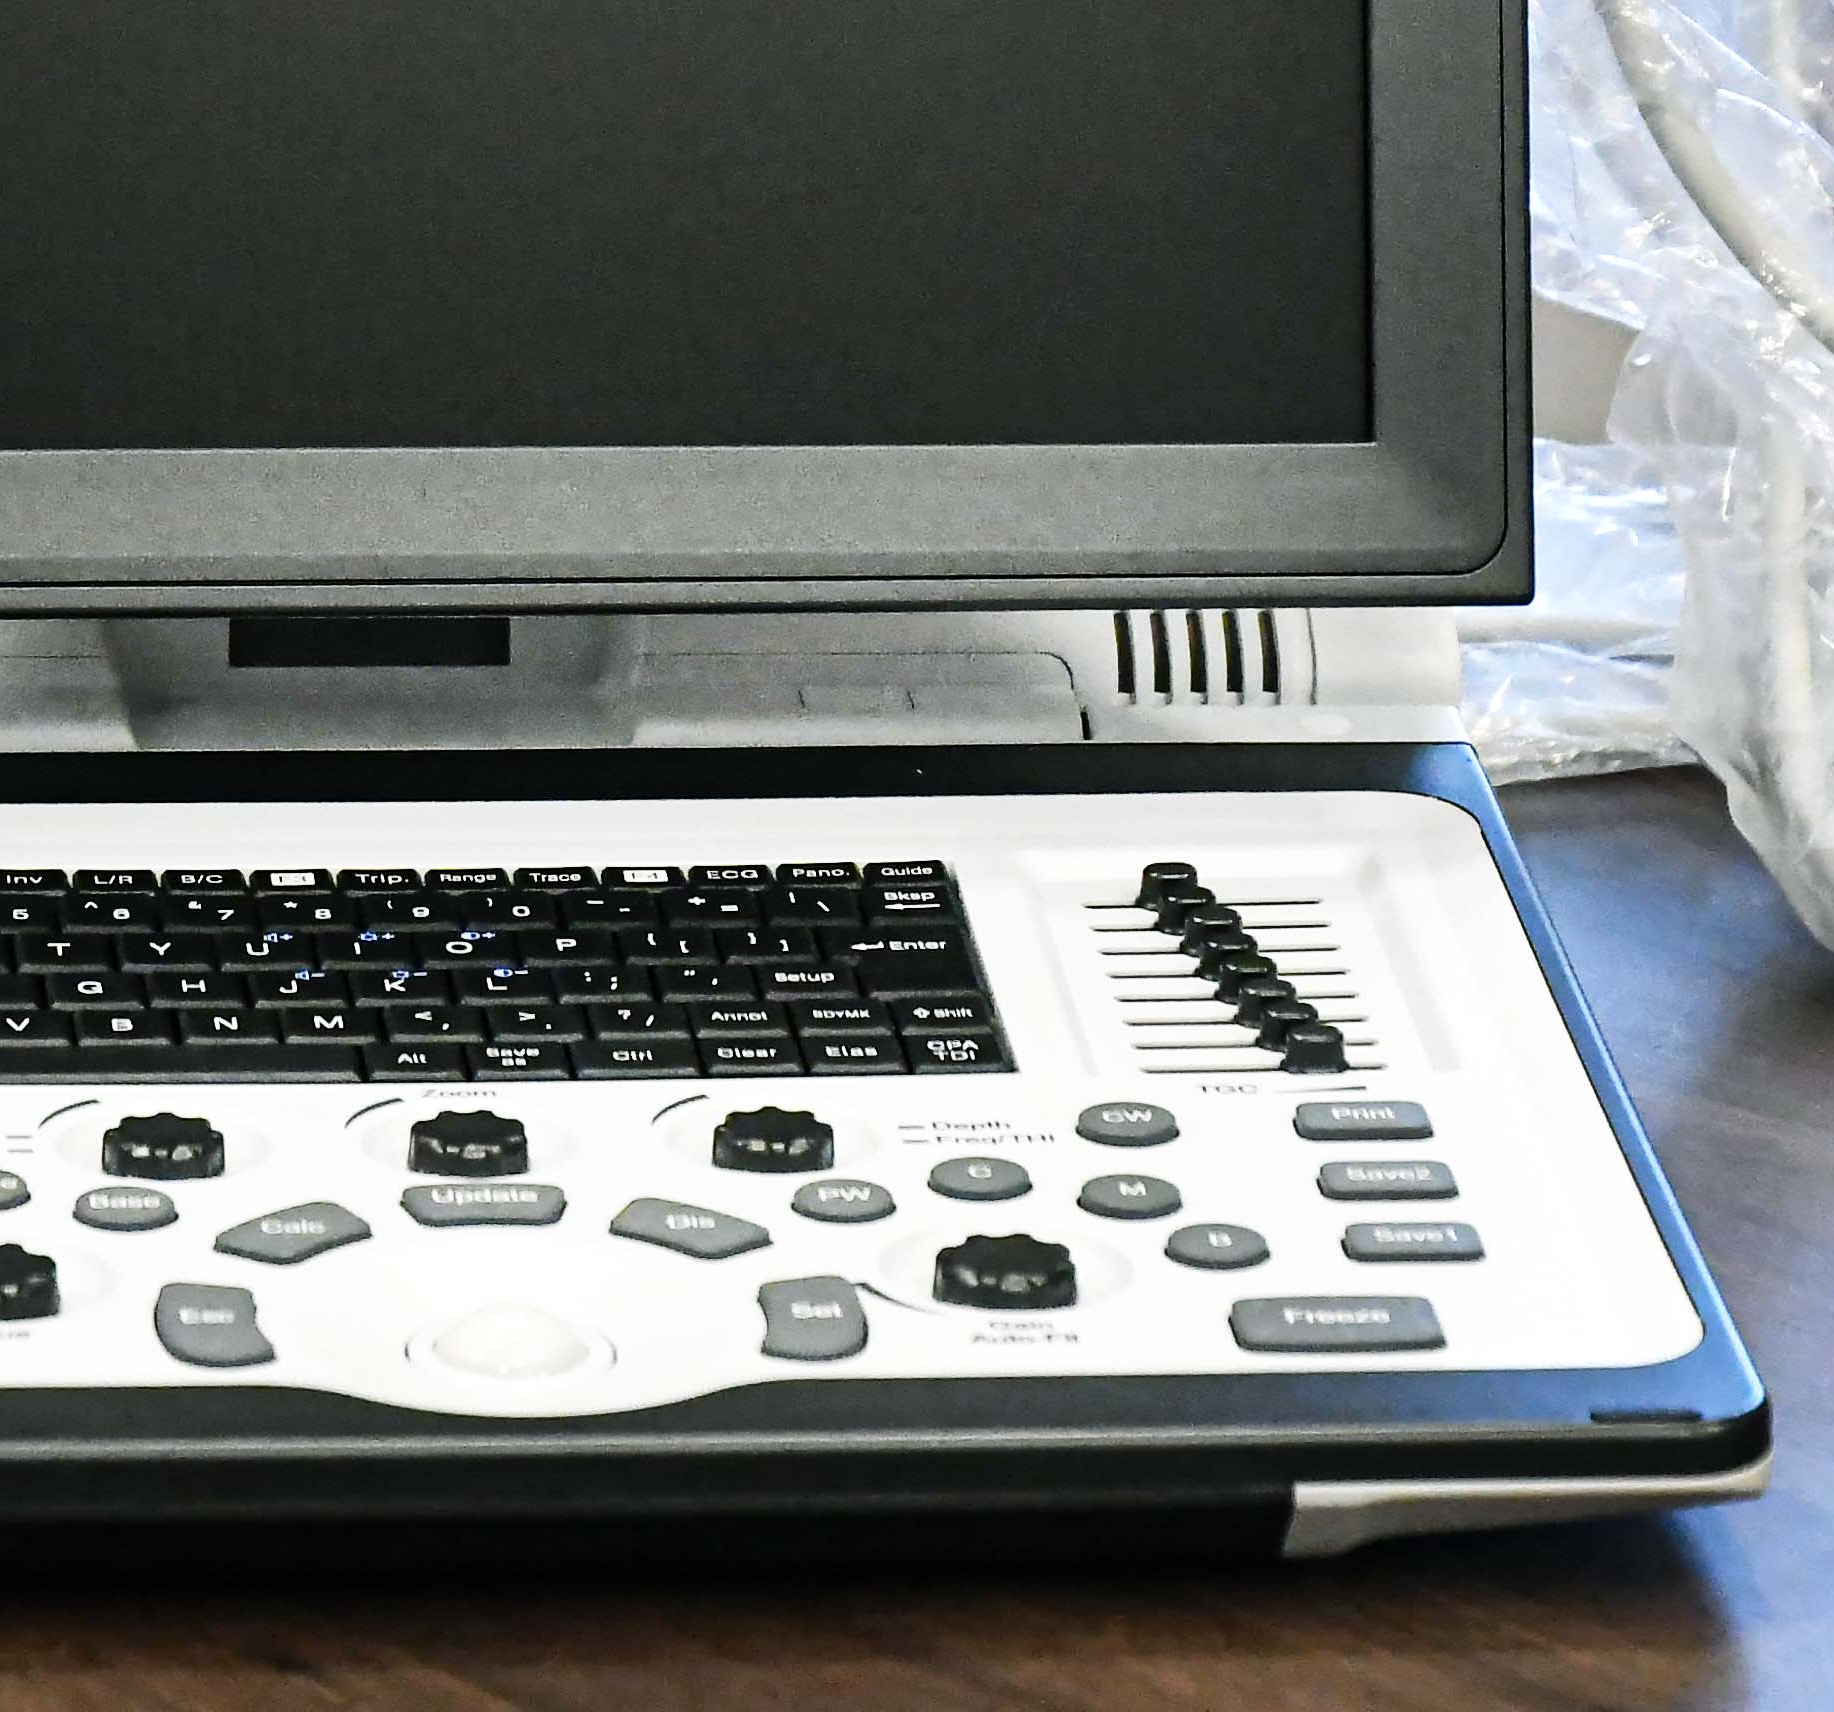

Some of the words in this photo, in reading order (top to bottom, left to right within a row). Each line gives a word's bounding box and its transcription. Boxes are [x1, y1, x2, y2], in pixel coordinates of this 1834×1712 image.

[707, 870, 758, 879] ECG
[793, 869, 849, 877] Pano.
[881, 866, 932, 875] Guide
[7, 875, 42, 883] Inv
[94, 876, 132, 884] L/R
[182, 875, 222, 883] B/C
[356, 874, 408, 884] Trip.
[440, 874, 496, 883] Range
[529, 873, 581, 882] Trace
[884, 891, 935, 901] Bksp
[13, 909, 29, 919] 5
[113, 909, 129, 919] 6
[218, 910, 234, 920] 7
[315, 909, 331, 919] 8
[413, 907, 429, 917] 9
[513, 906, 530, 917] 0
[47, 943, 70, 956] T
[150, 943, 171, 955] Y
[246, 943, 269, 956] U
[354, 942, 360, 954] I
[446, 942, 472, 953] O
[556, 939, 576, 951] P
[889, 941, 946, 950] Enter
[775, 973, 834, 983] Setup
[78, 981, 103, 994] G
[182, 980, 206, 992] H
[279, 980, 297, 994] J
[384, 979, 406, 992] K
[486, 977, 507, 991] L
[712, 1012, 767, 1021] Annot
[934, 1008, 972, 1018] Shift
[7, 1018, 29, 1031] V
[112, 1019, 133, 1031] B
[214, 1017, 238, 1030] N
[314, 1016, 343, 1028] M
[398, 1053, 426, 1063] Alt
[613, 1050, 652, 1061] Ctrl
[718, 1048, 776, 1058] Clear
[1330, 1106, 1396, 1122] Print
[931, 1120, 1011, 1133] Depth
[1118, 1180, 1147, 1198] M
[431, 1187, 538, 1205] Update
[817, 1187, 872, 1204] PW
[1282, 1306, 1393, 1328] Freeze
